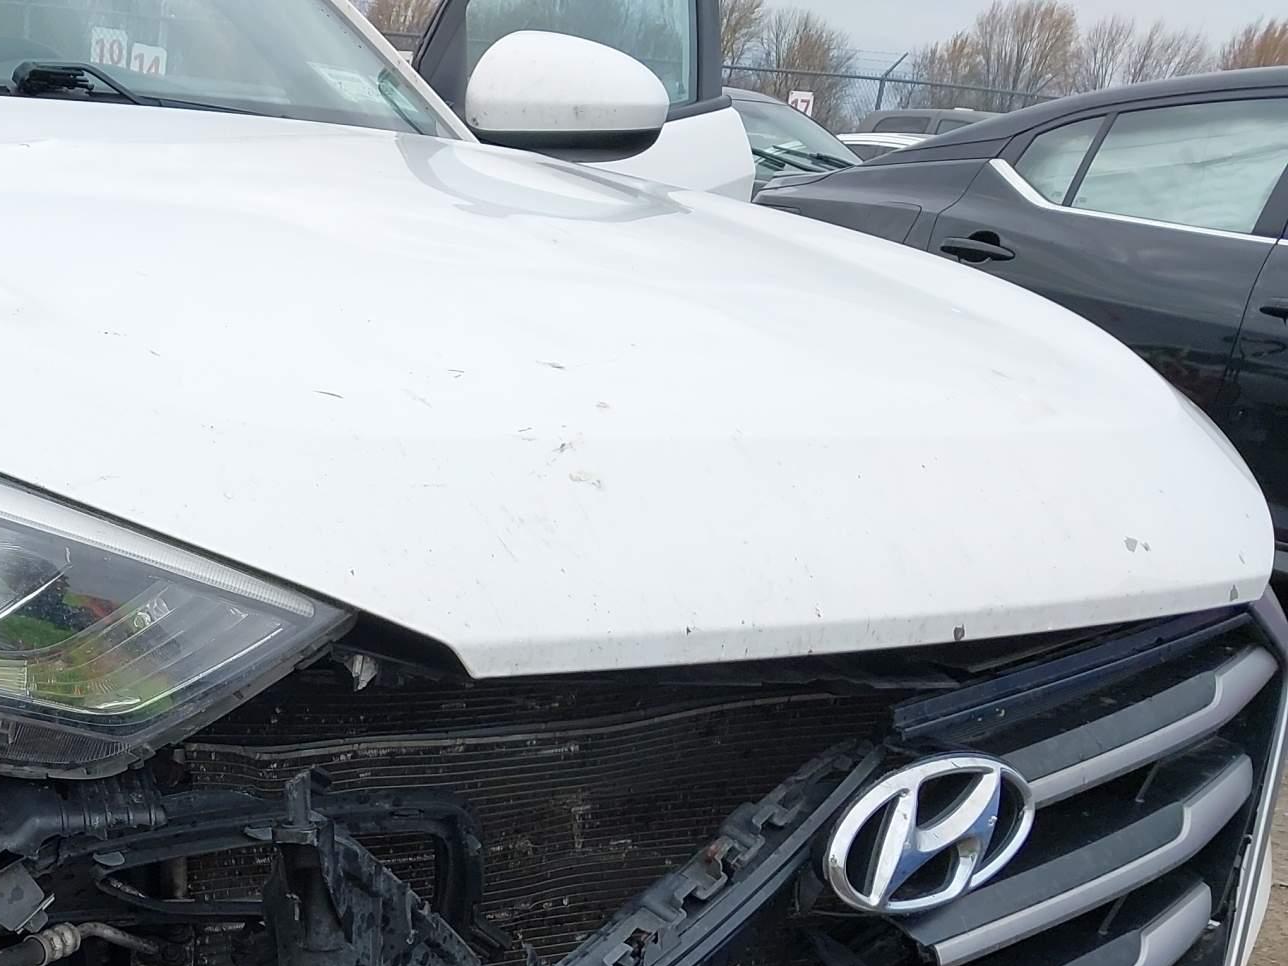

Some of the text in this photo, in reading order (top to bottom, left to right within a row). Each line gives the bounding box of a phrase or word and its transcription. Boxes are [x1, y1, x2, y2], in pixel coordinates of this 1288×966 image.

[94, 38, 123, 65] 10
[133, 52, 161, 75] 14
[791, 98, 811, 112] 17
